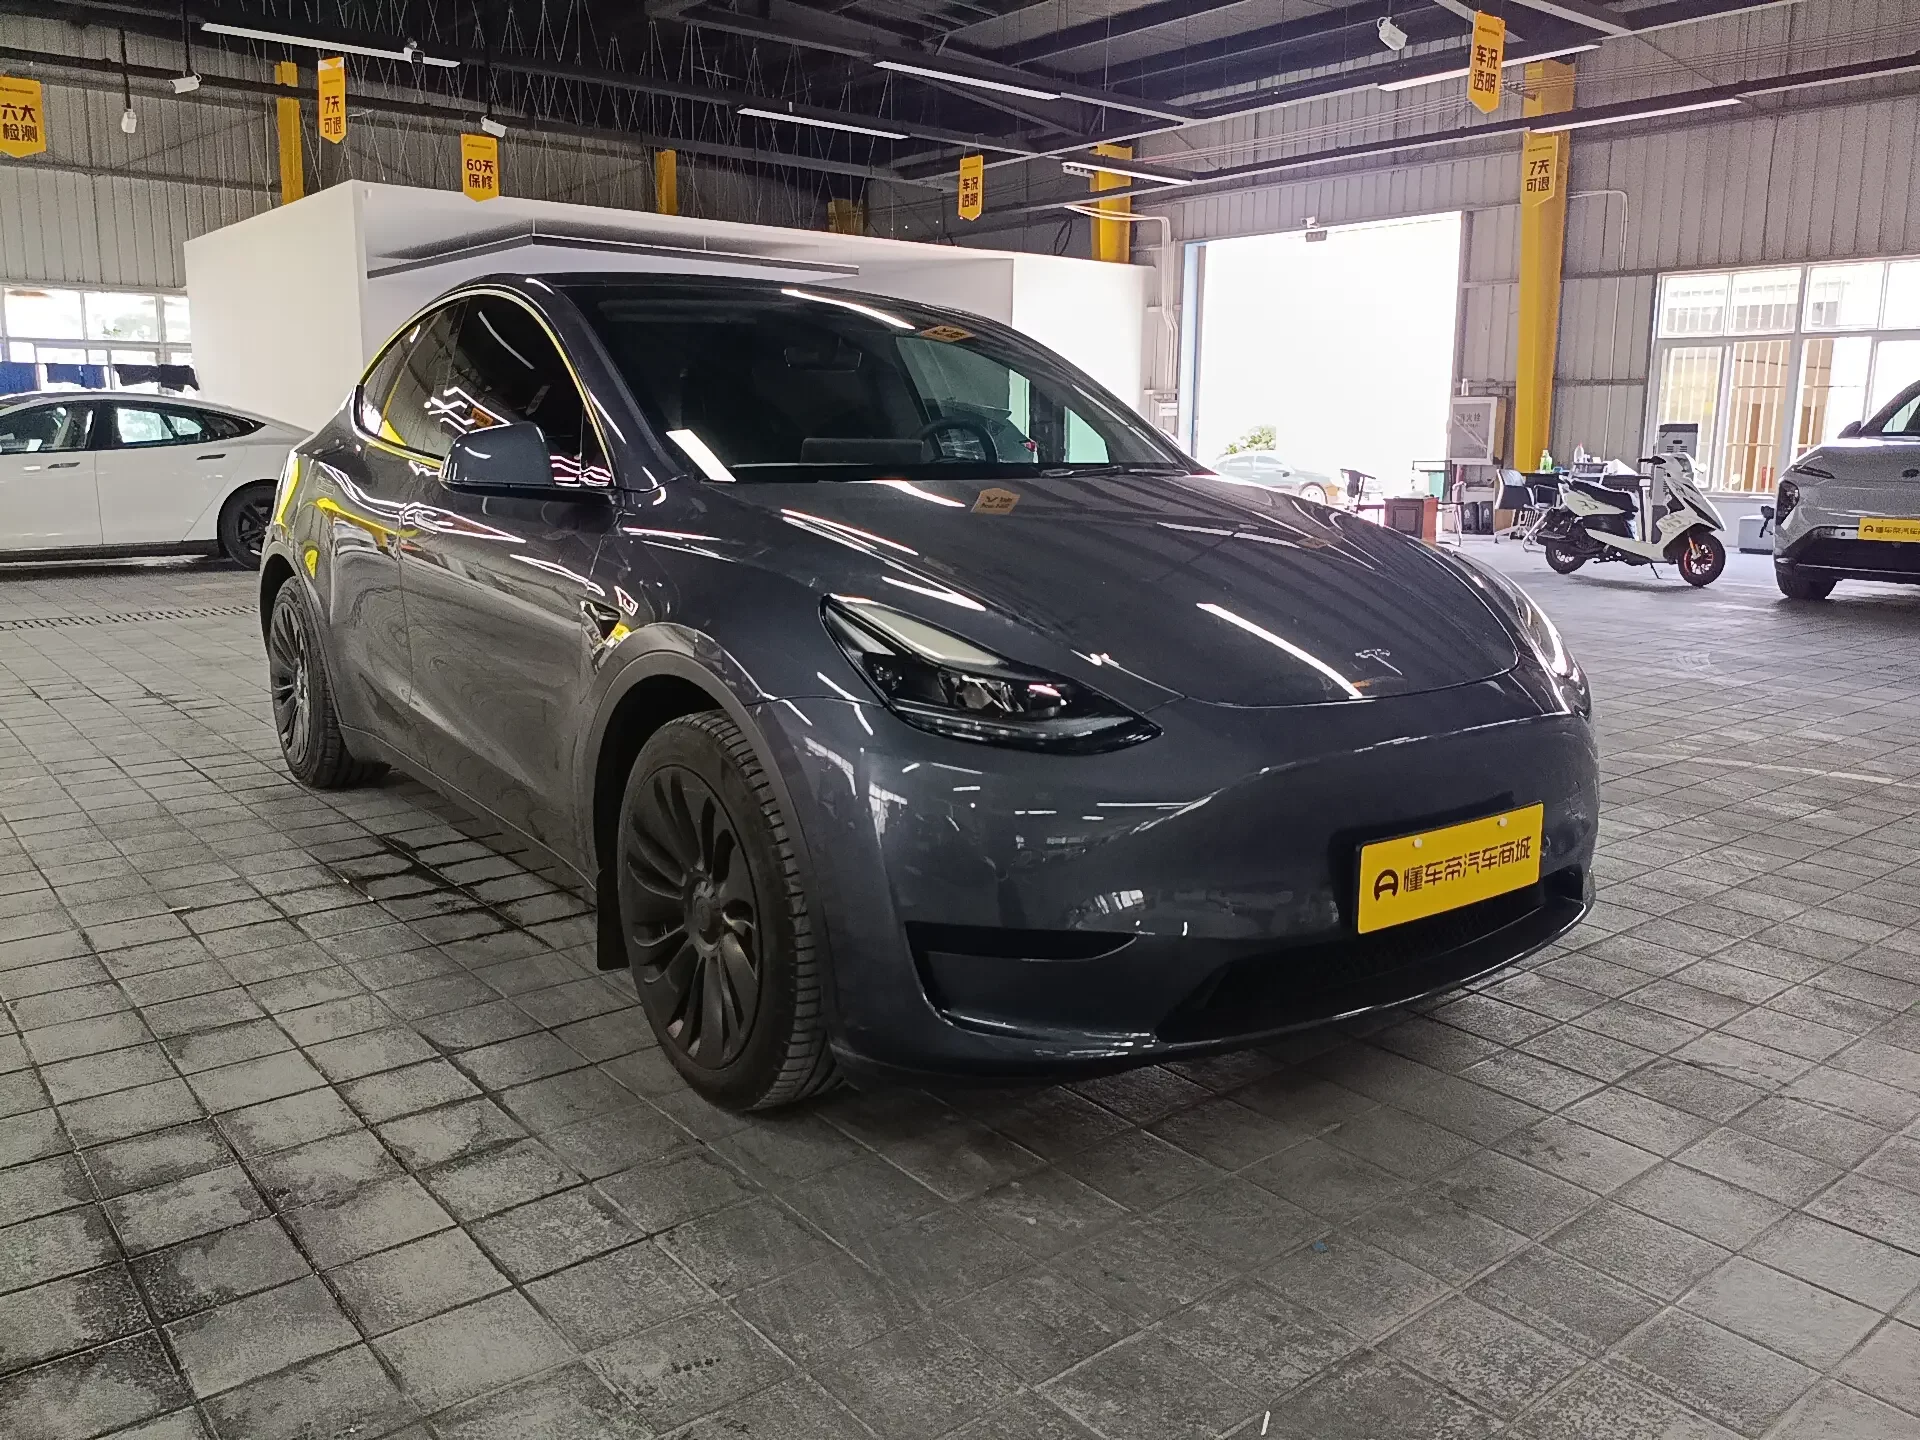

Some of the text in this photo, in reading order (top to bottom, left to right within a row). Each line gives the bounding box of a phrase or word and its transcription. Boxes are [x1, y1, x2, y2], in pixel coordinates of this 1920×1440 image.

[1475, 44, 1498, 70] 车况
[1473, 69, 1497, 94] 透明
[1, 102, 36, 123] 六大
[324, 95, 340, 114] 7天
[2, 123, 38, 142] 检测
[323, 116, 342, 135] 可退
[466, 158, 494, 174] 60天
[1529, 158, 1549, 176] 7天
[468, 173, 493, 189] 保修
[962, 176, 979, 191] 车况
[1526, 176, 1549, 192] 可退
[962, 192, 978, 208] 透明
[1403, 835, 1532, 892] 懂车帝汽车商城
